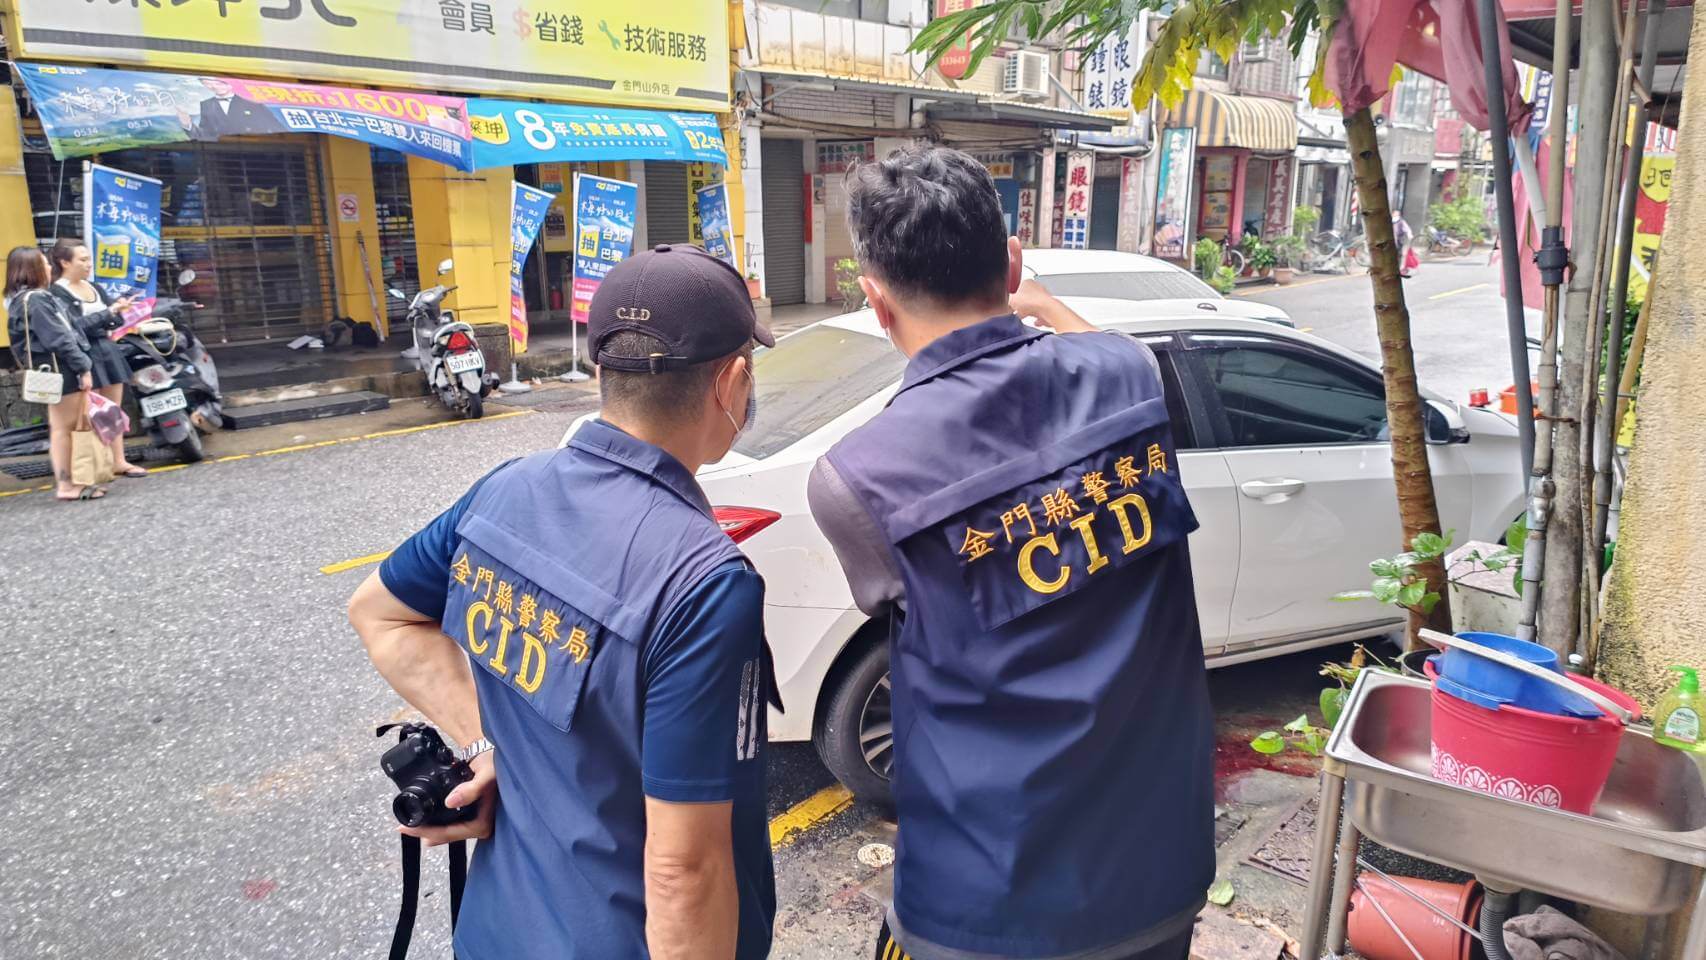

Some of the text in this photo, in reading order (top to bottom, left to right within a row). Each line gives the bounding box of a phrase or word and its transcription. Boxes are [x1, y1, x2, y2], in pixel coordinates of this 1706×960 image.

[438, 0, 495, 35] 會員
[535, 11, 584, 45] 省錢
[623, 24, 706, 62] 技術服務
[623, 80, 670, 95] 金門山外店
[1111, 40, 1131, 108] 眼鏡
[581, 234, 596, 252] 抽
[602, 226, 626, 243] 台北
[101, 248, 124, 270] 抽
[959, 443, 1169, 563] 金門縣警察局
[1017, 493, 1153, 594] CID
[452, 553, 592, 664] 金門縣警察局
[466, 601, 547, 694] CID
